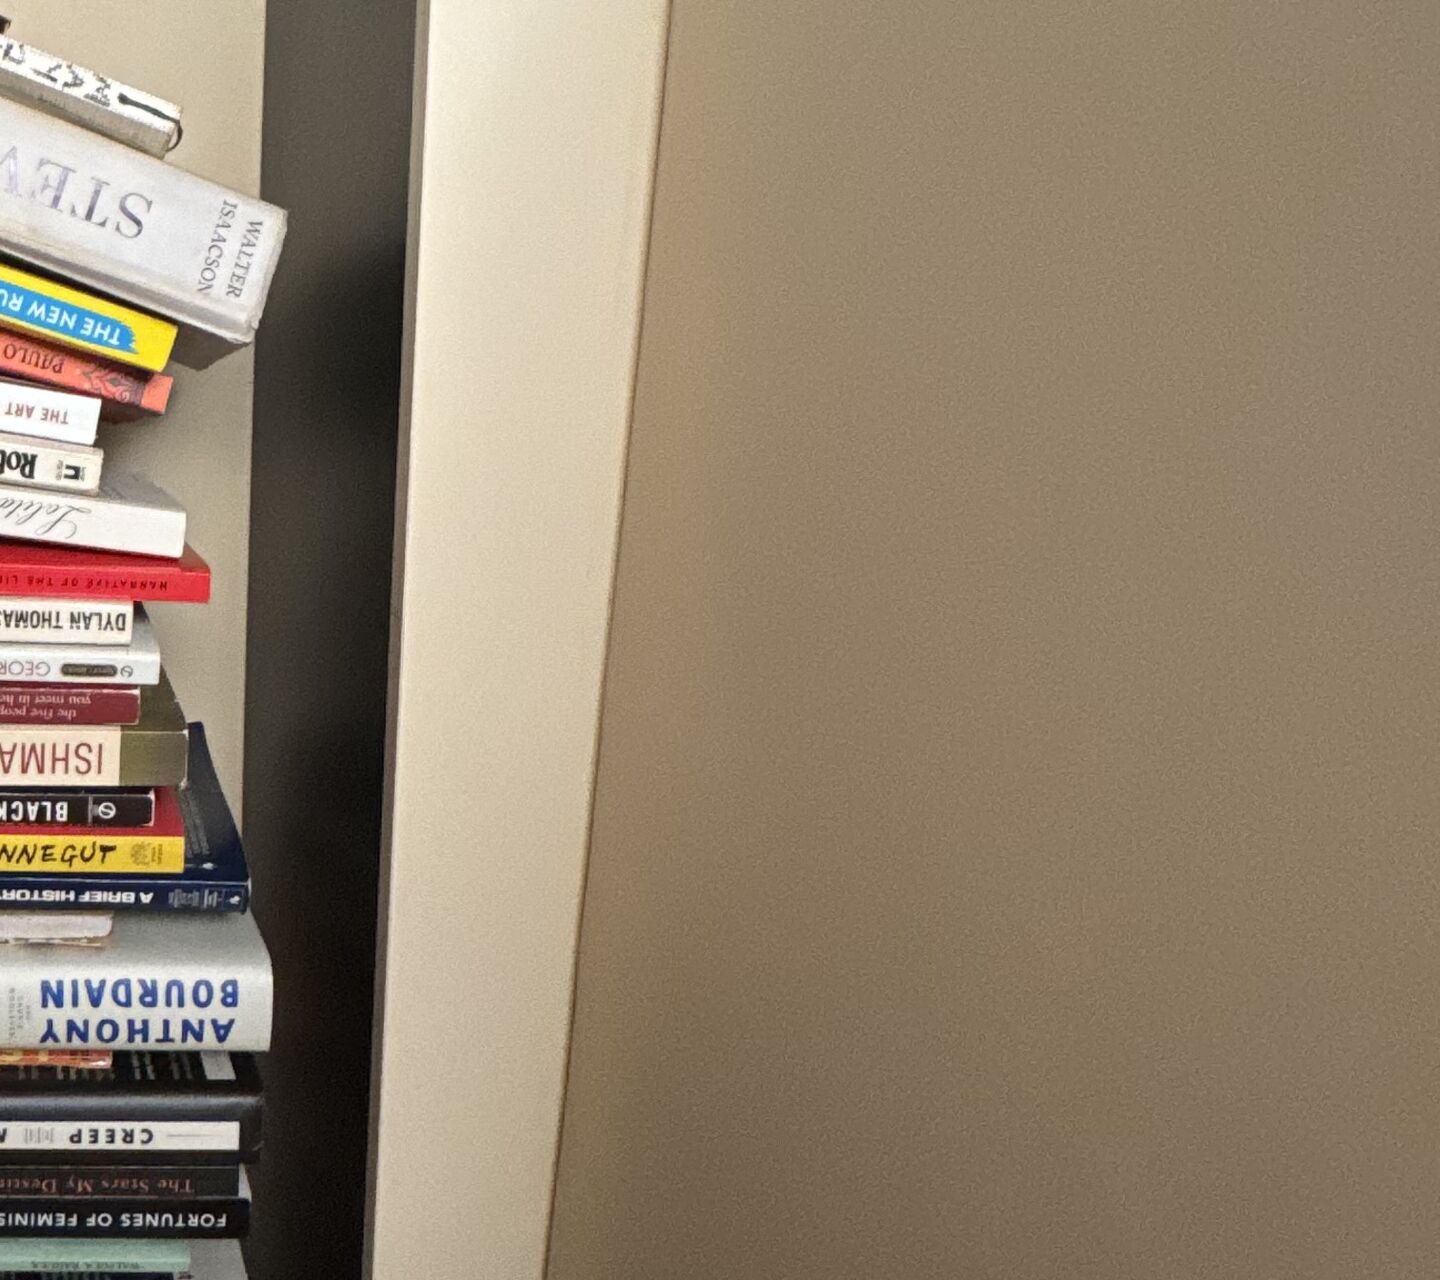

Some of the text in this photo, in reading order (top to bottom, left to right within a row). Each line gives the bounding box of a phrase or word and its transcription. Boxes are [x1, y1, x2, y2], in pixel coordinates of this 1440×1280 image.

[196, 199, 238, 295] ISAACSON
[225, 221, 263, 298] WALTER
[27, 300, 78, 329] NEW
[80, 317, 121, 346] THE
[4, 344, 64, 374] PAULO
[5, 402, 35, 419] ART
[41, 408, 70, 424] THE
[0, 498, 92, 540] Lolita
[27, 575, 52, 586] THE
[62, 577, 78, 587] OF
[88, 578, 168, 591] NARRATIVE
[70, 612, 127, 632] DYLAN
[18, 695, 30, 706] in
[34, 695, 64, 705] meet
[68, 692, 91, 705] you
[58, 709, 76, 720] the
[79, 890, 136, 904] BRIEF
[140, 892, 154, 904] A
[40, 979, 239, 1008] BOURDAIN
[40, 1018, 235, 1044] ANTHONY
[68, 1128, 154, 1144] CREEP
[68, 1176, 93, 1194] My
[101, 1180, 150, 1194] Stars
[158, 1180, 195, 1194] The
[86, 1213, 112, 1227] OF
[120, 1213, 227, 1228] FORTUNES
